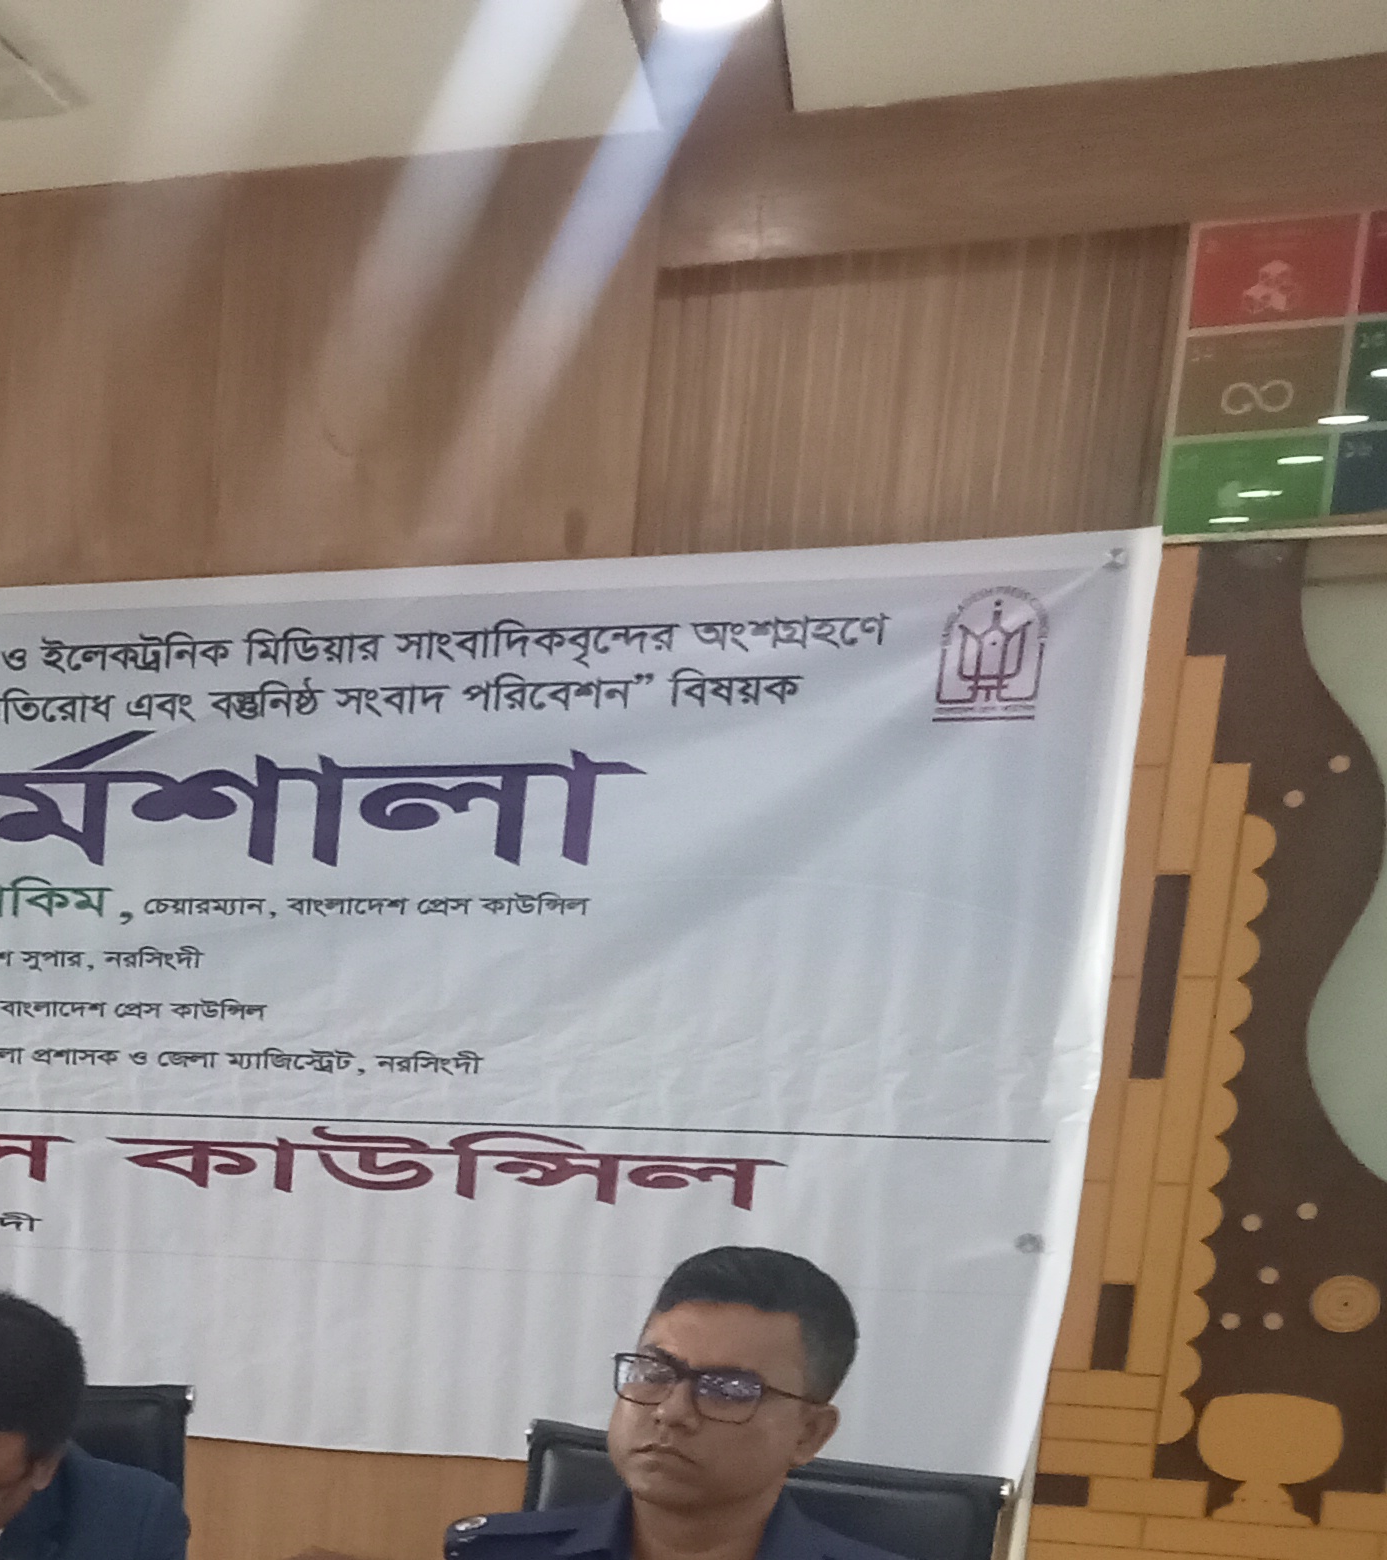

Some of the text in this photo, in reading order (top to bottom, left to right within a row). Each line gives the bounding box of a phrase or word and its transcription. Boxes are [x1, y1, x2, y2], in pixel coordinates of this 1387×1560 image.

[2, 649, 27, 671] ও
[242, 627, 384, 666] মিডিয়ার
[395, 618, 680, 667] সাংবাদিকবৃন্দের
[692, 613, 891, 651] অংশগ্রহণে
[125, 692, 195, 722] এবং
[208, 677, 325, 719] বস্তুনিষ্ঠ
[333, 684, 450, 717] সংবাদ
[461, 670, 655, 711] পরিবেশন”
[670, 668, 803, 707] বিষয়ক
[144, 896, 277, 921] চেয়ারম্যান,
[287, 896, 409, 918] বাংলাদেশ
[416, 896, 470, 918] প্রেস
[480, 891, 592, 918] কাউন্সিল
[23, 949, 94, 972] সুপার,
[103, 945, 205, 969] নরসিংদী
[0, 998, 106, 1019] বাংলাদেশ
[114, 1000, 161, 1019] প্রেস
[170, 998, 269, 1021] কাউন্সিল
[31, 1047, 122, 1067] প্রশাসক
[129, 1051, 147, 1066] ও
[157, 1050, 219, 1071] জেলা
[228, 1046, 366, 1077] ম্যাজিস্ট্রেট,
[374, 1047, 486, 1076] নরসিংদী
[106, 1125, 786, 1212] কাউন্সিল
